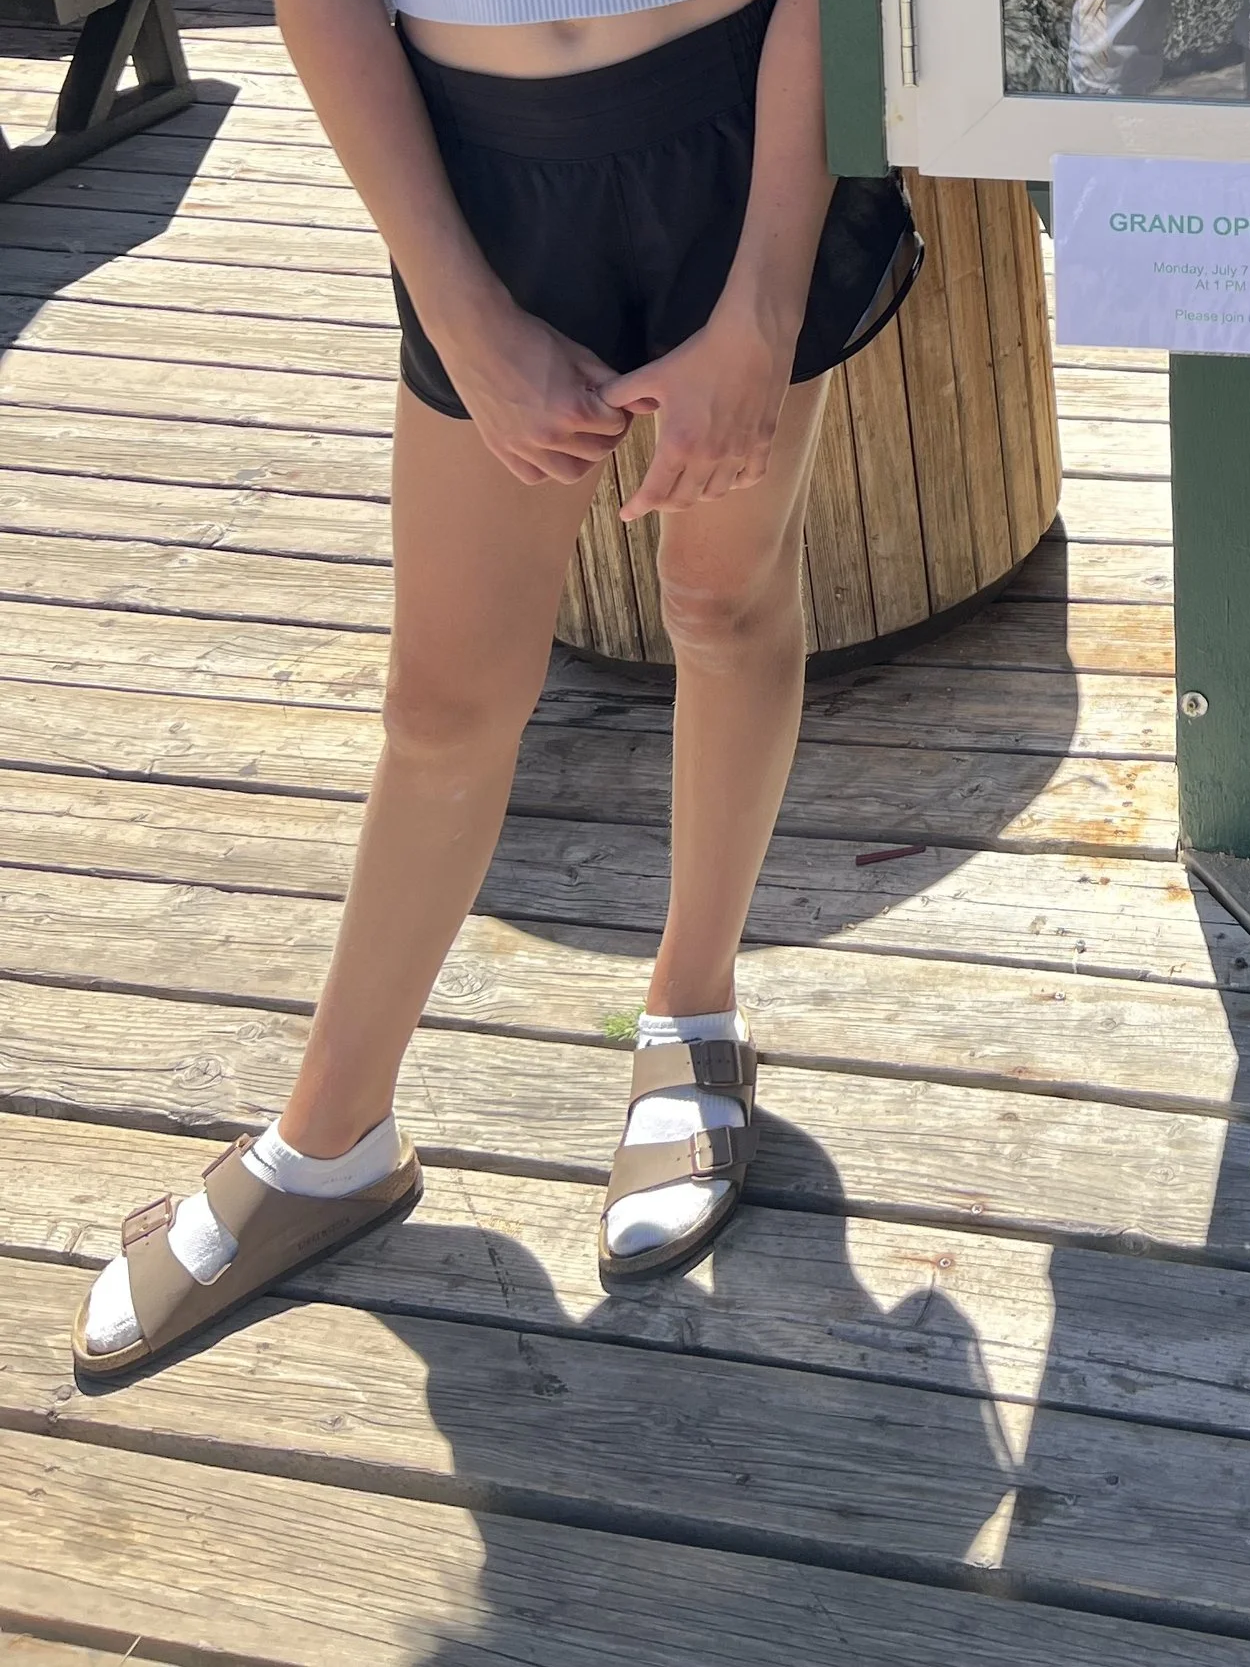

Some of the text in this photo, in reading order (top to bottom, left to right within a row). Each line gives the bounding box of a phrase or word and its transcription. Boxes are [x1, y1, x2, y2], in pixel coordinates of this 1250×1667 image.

[1109, 212, 1205, 235] GRAND
[1153, 261, 1208, 277] Monday,
[1211, 264, 1237, 278] July
[1195, 279, 1247, 292] At 1 PM
[1175, 308, 1218, 322] Please
[1221, 312, 1244, 325] join
